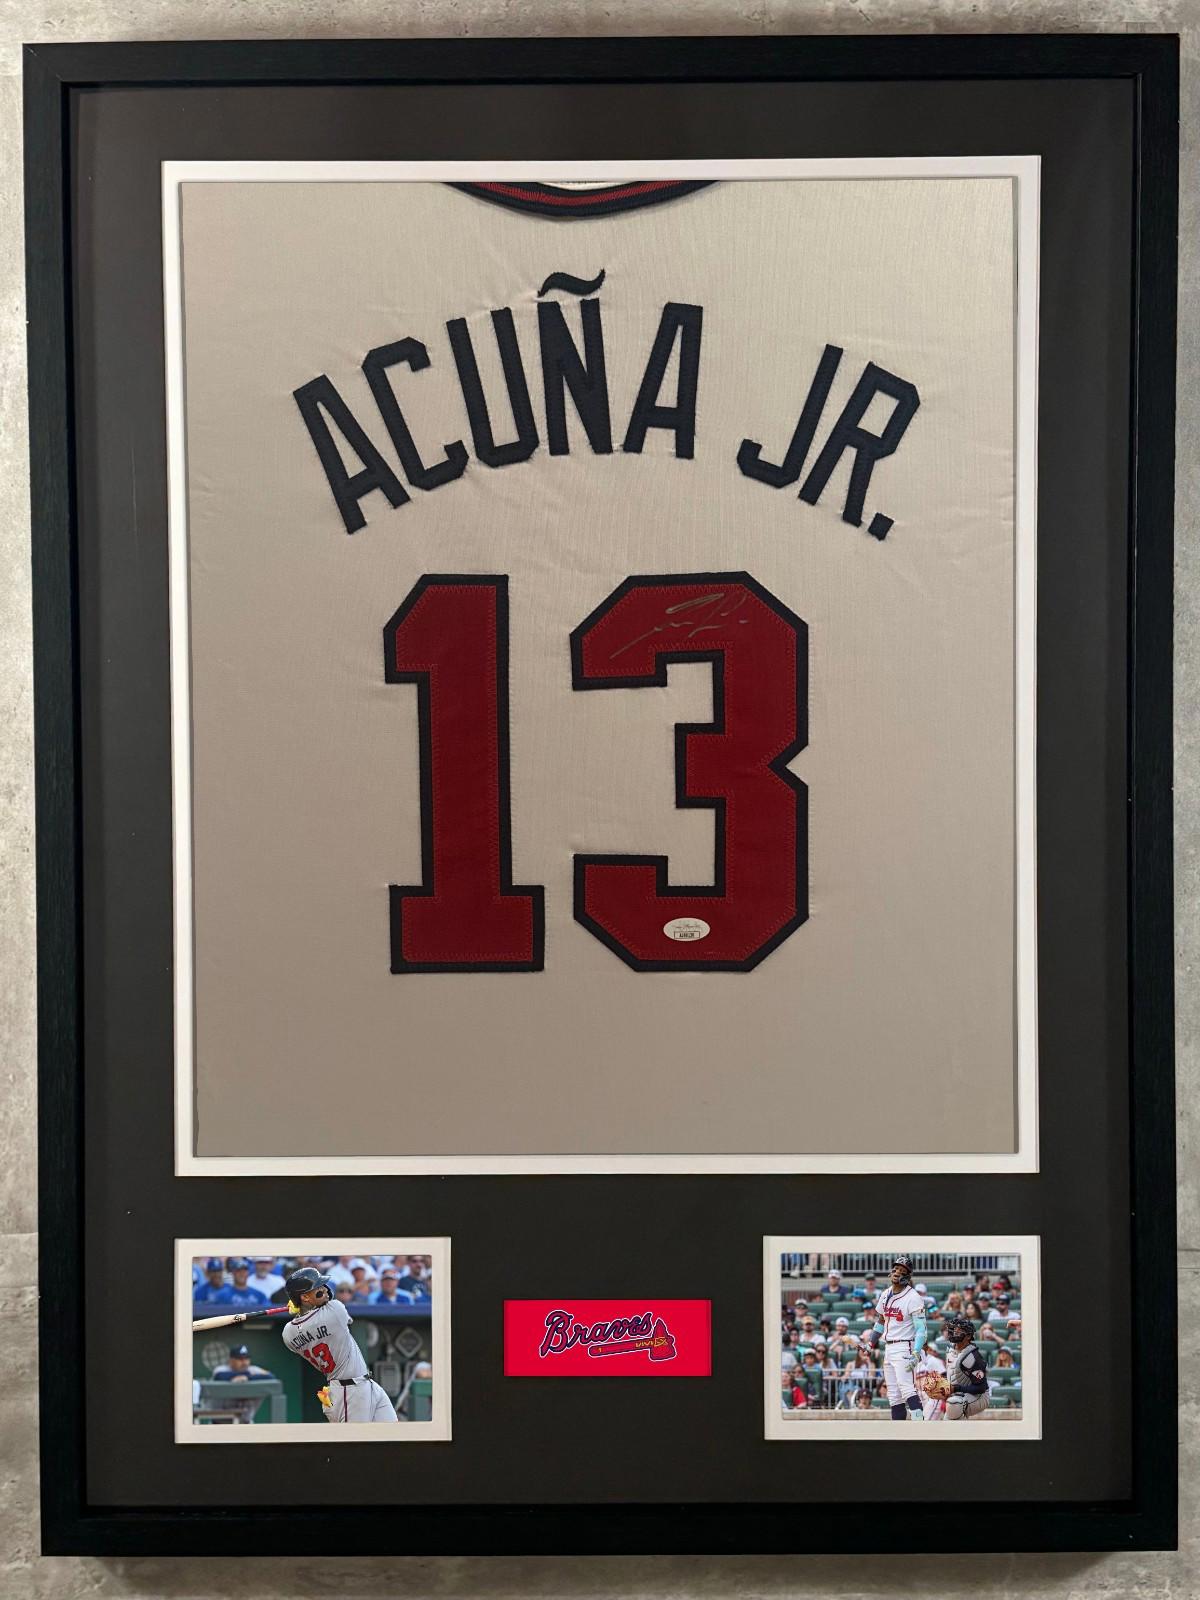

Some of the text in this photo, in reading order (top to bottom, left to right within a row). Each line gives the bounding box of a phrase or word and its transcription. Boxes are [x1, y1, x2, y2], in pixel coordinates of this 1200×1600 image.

[293, 268, 921, 541] ACUÑA JR.
[382, 570, 810, 975] 13
[316, 1325, 332, 1340] JR.
[539, 1309, 654, 1359] Braves
[303, 1342, 337, 1376] 13
